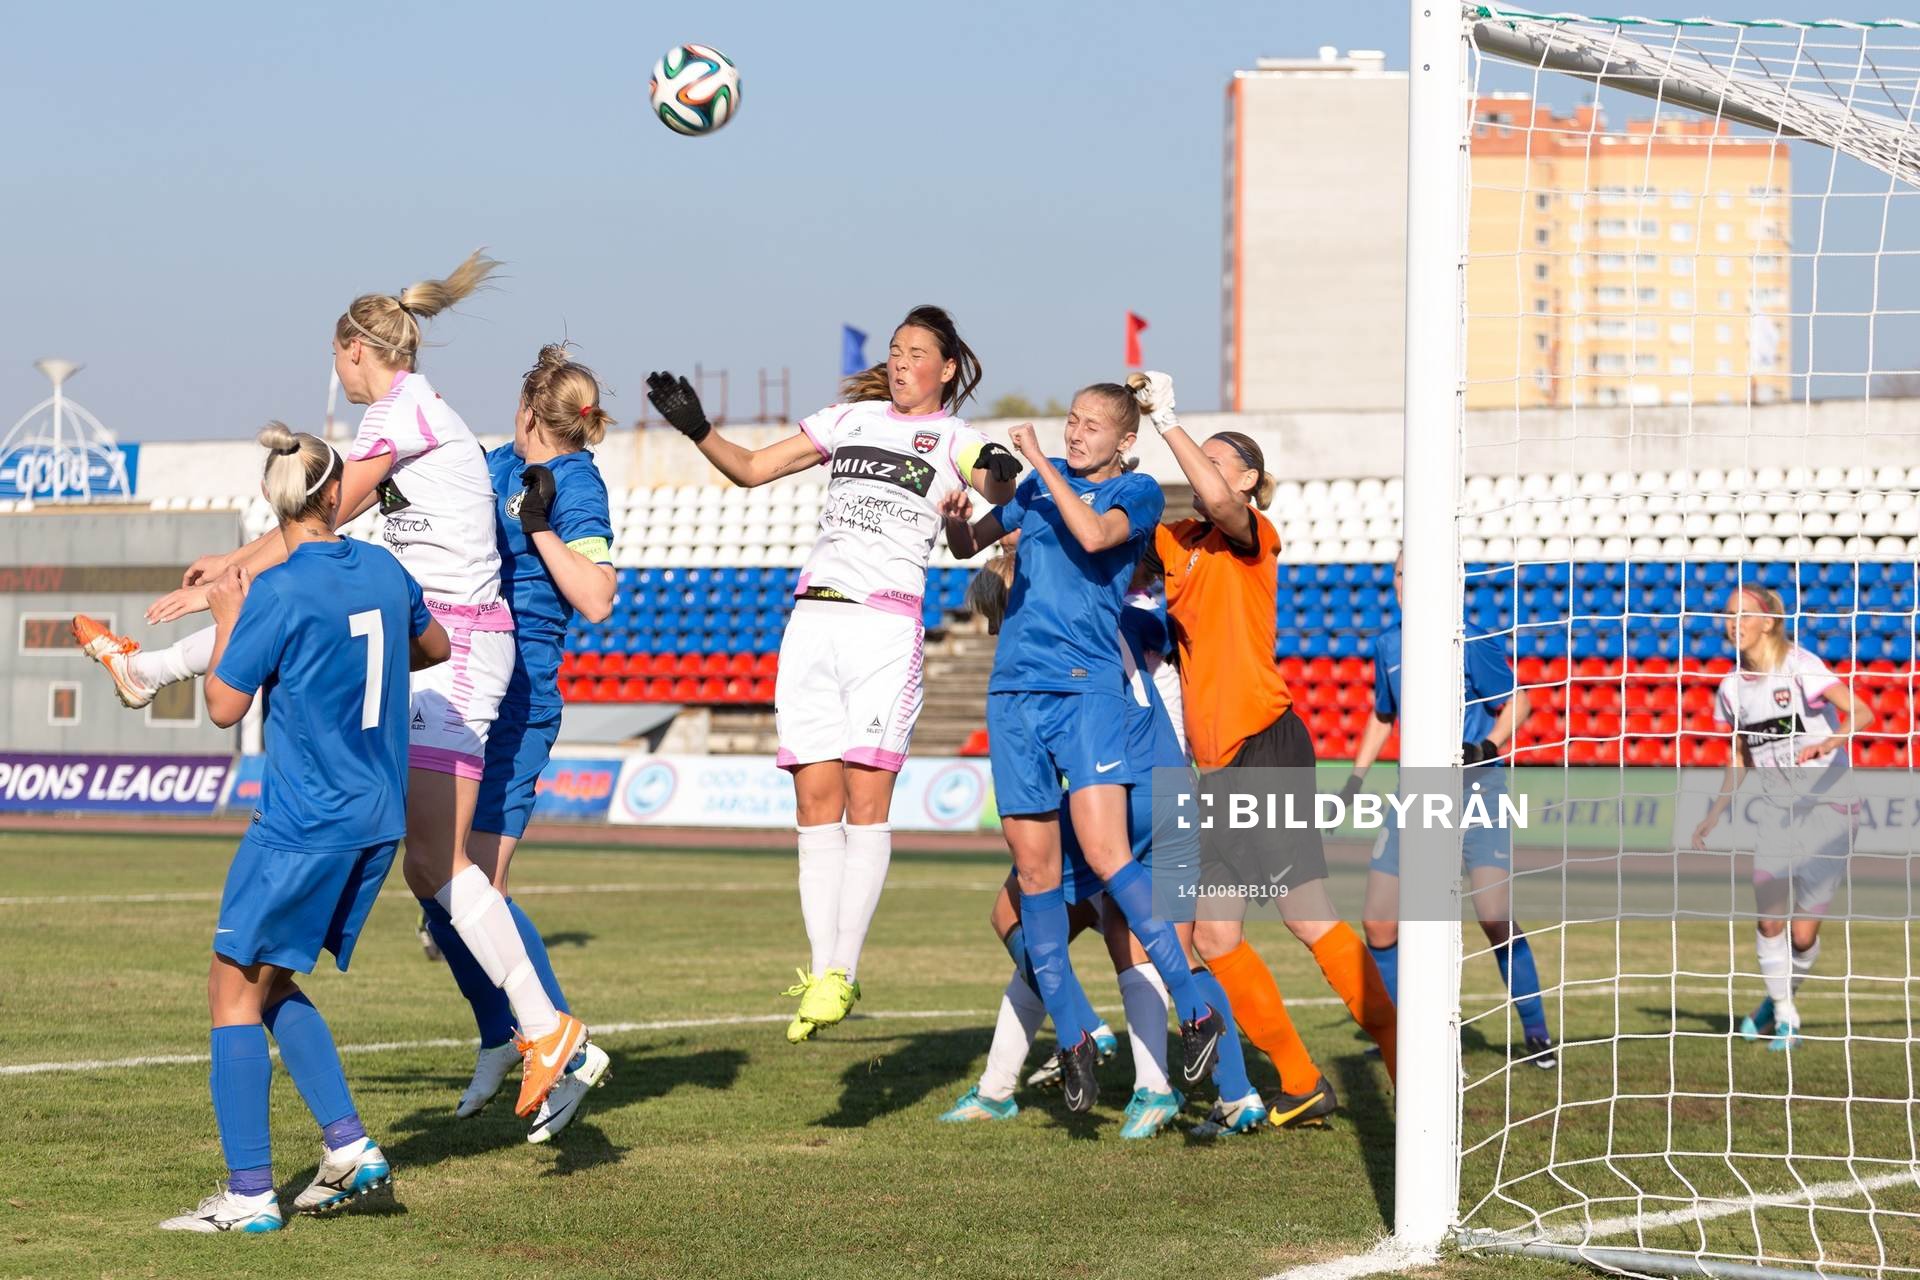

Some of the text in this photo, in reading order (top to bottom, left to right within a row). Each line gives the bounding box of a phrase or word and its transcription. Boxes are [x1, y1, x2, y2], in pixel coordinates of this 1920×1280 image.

[833, 458, 897, 478] MIKZ
[427, 600, 452, 612] SELECT
[88, 764, 226, 803] LEAGUE
